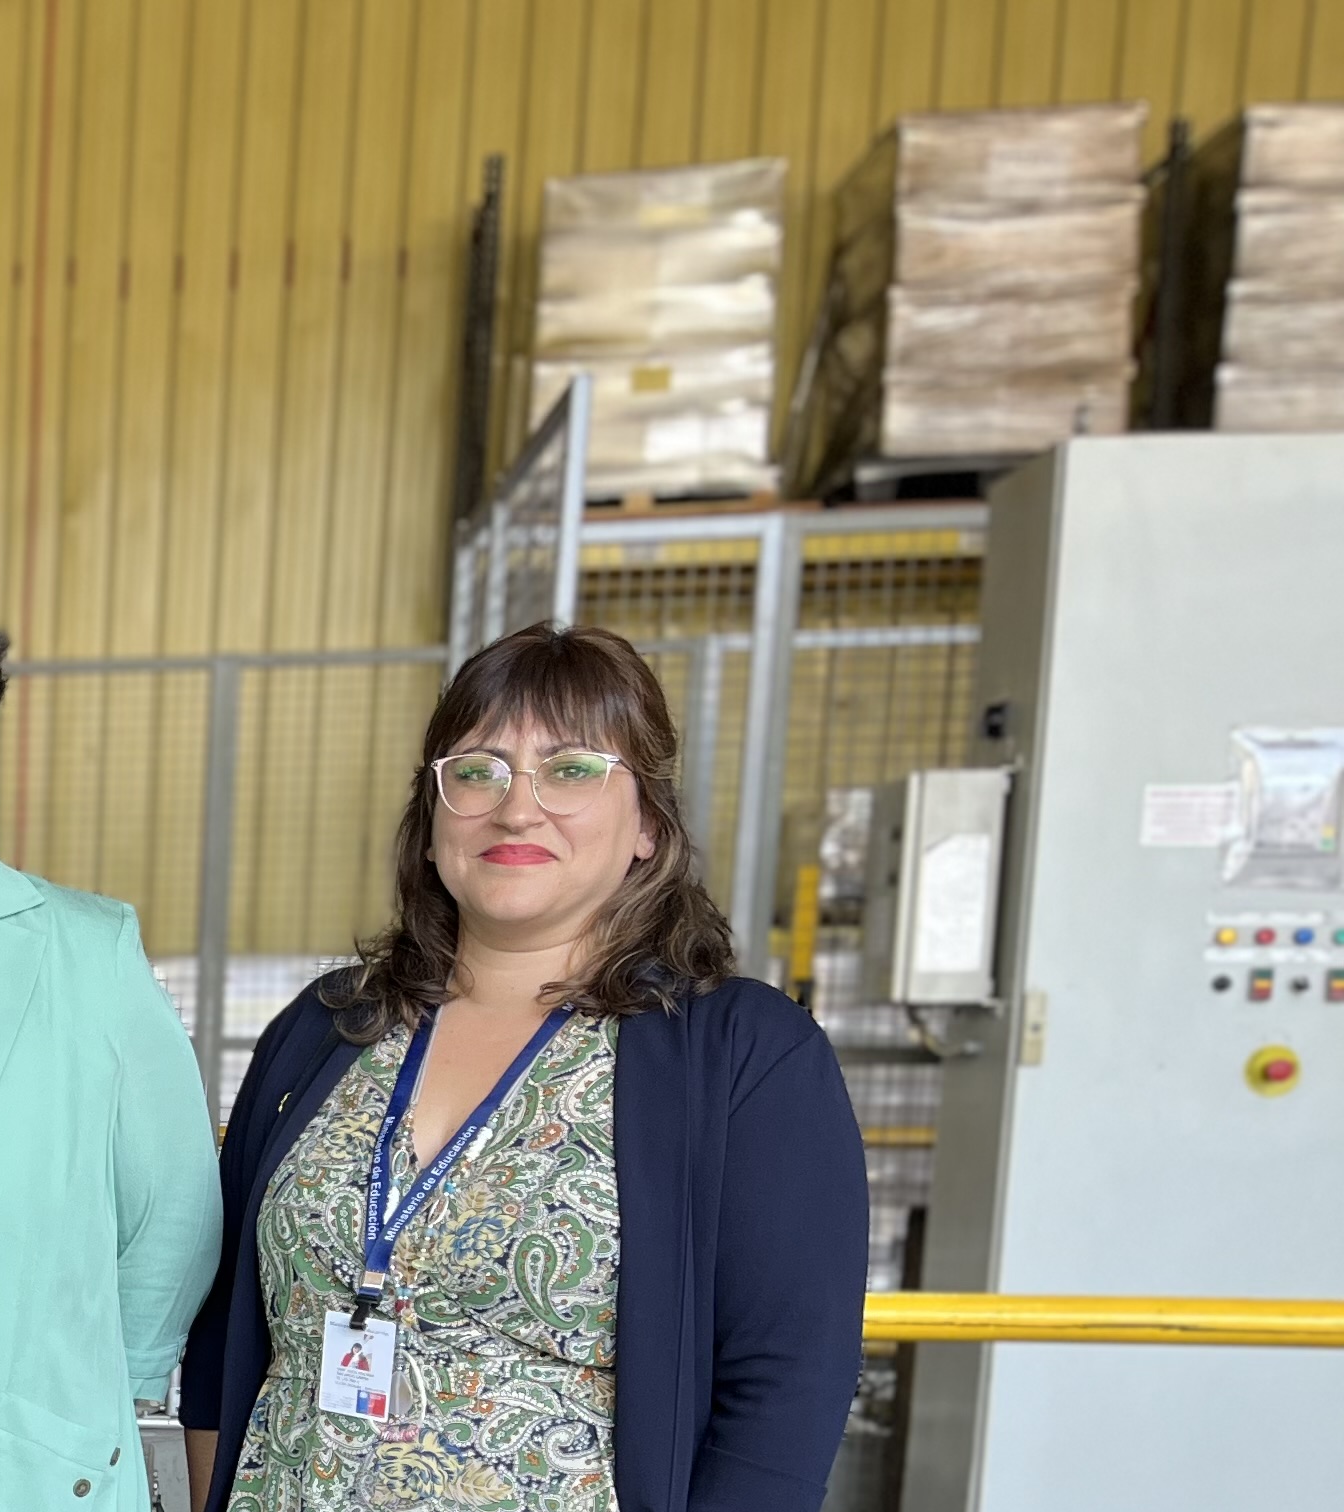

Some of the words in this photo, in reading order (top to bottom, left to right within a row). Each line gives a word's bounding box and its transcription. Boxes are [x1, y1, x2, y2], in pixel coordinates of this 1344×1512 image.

[372, 1167, 383, 1180] de
[384, 1193, 425, 1241] Ministerio
[422, 1178, 436, 1191] de
[431, 1125, 477, 1176] Educación
[367, 1182, 382, 1240] Educación
